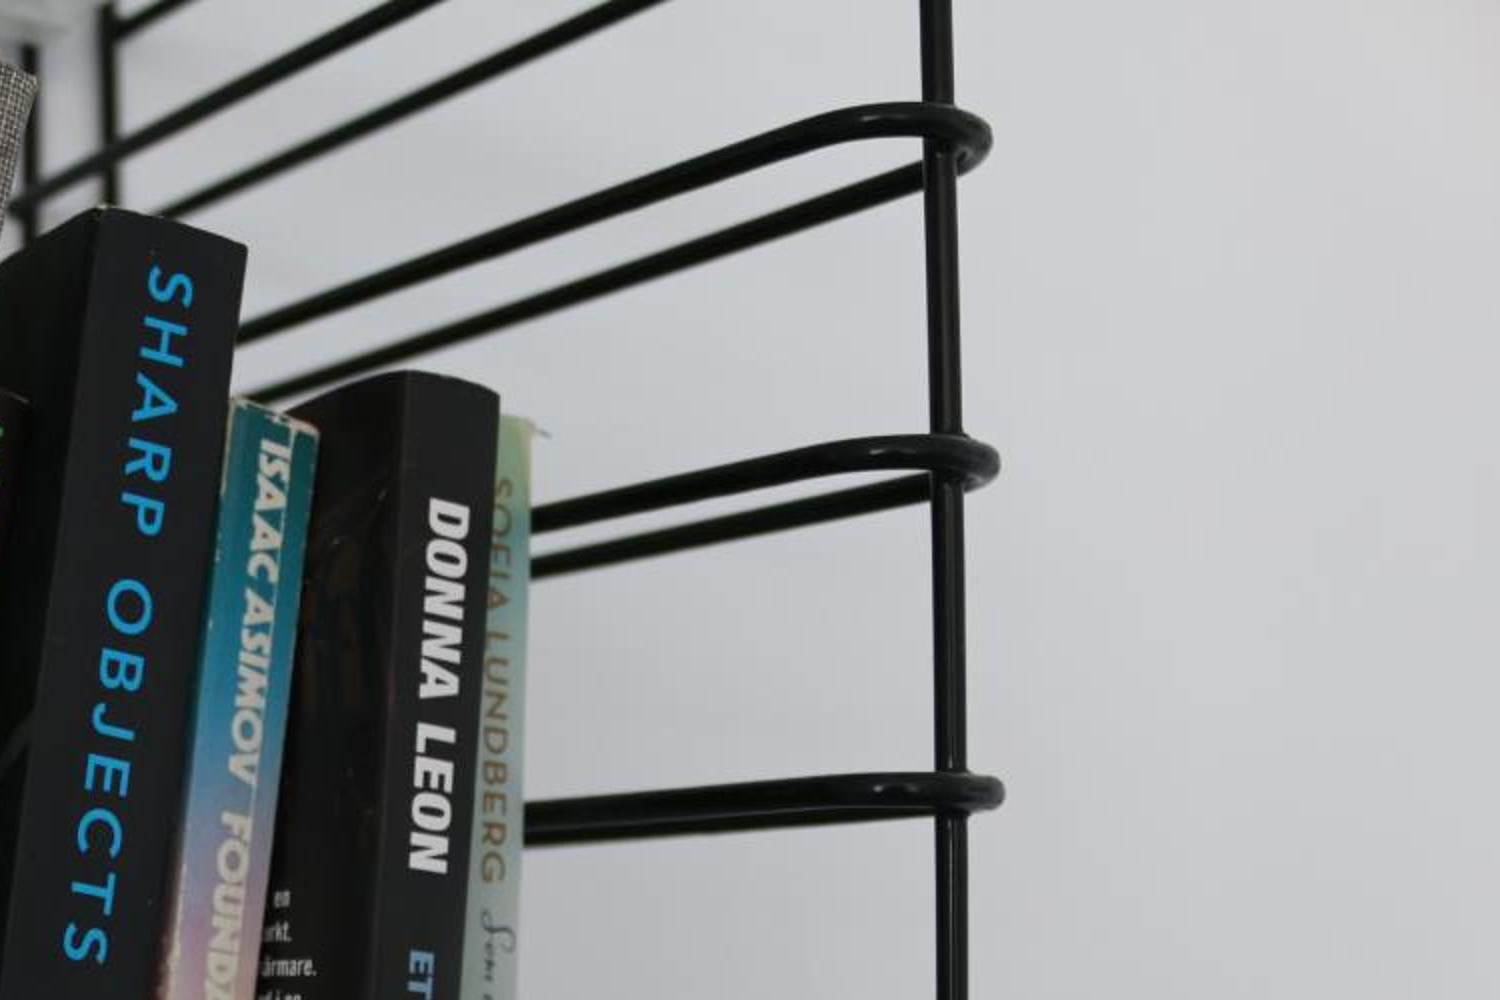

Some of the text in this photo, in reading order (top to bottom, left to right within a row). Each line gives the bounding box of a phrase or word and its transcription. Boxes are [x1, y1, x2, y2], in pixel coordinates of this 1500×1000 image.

[121, 264, 194, 537] SHARP
[246, 437, 293, 585] ISAAC
[62, 578, 155, 964] OBJECTS
[228, 586, 277, 787] ASIMOV
[408, 497, 471, 875] DONNA LEON
[480, 632, 511, 884] LUNDBERG
